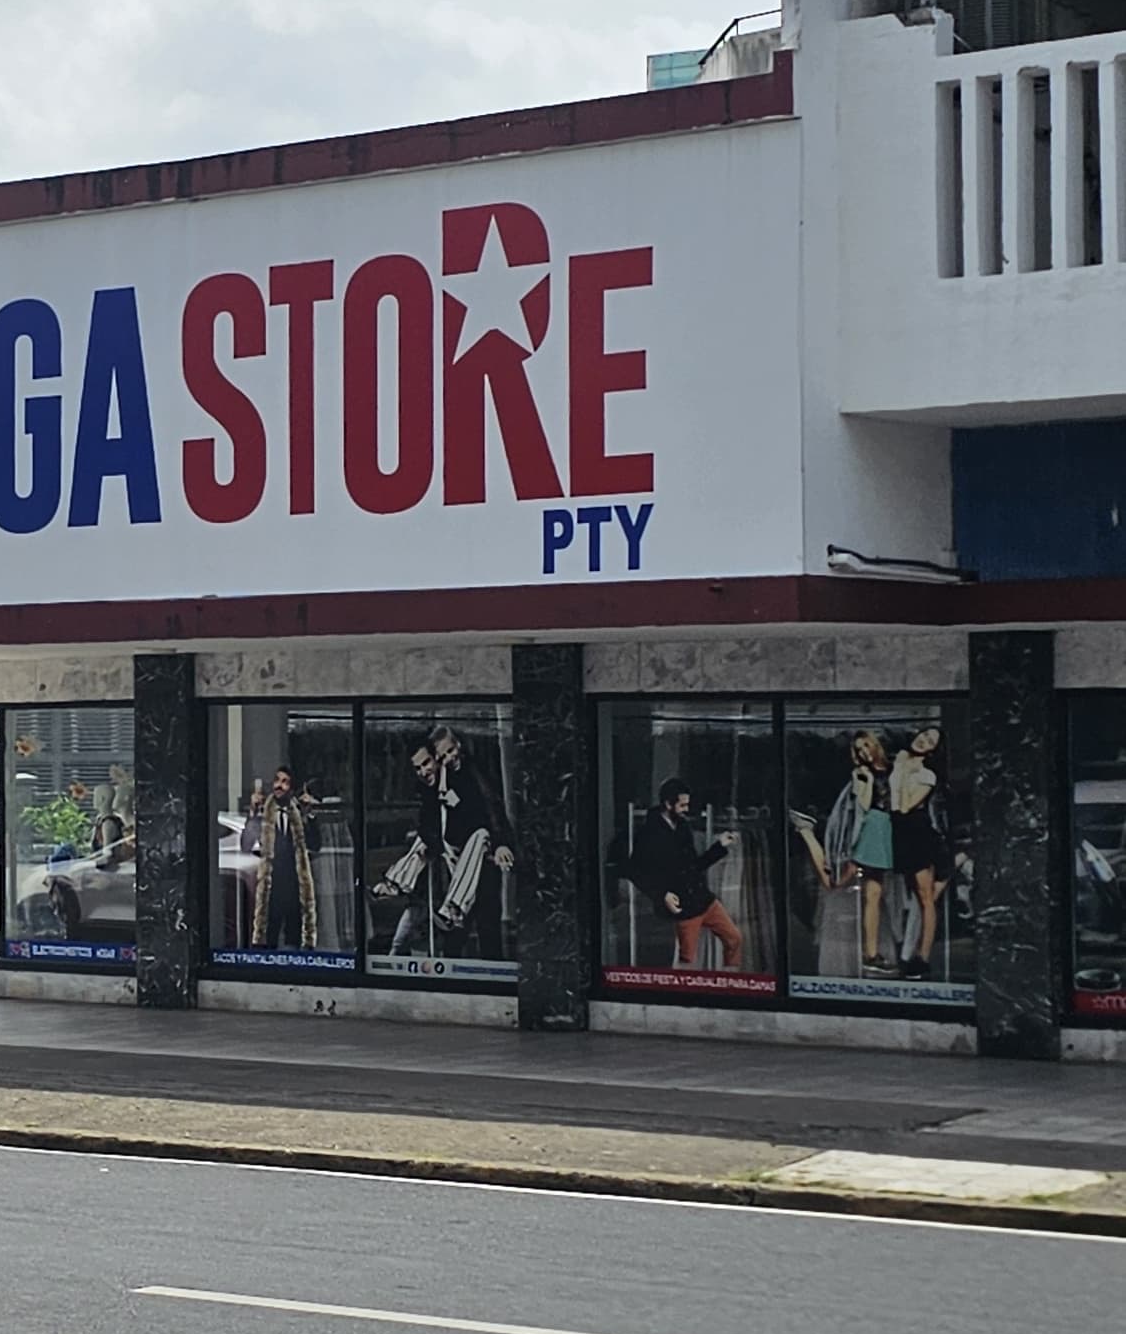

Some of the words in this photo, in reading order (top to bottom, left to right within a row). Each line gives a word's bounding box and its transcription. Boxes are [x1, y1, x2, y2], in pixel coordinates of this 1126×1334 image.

[544, 503, 653, 572] PTY
[289, 956, 307, 966] PARA
[308, 956, 355, 969] CABALLEROS
[729, 979, 749, 989] PARA
[792, 981, 838, 995] CALZADO
[839, 984, 865, 995] PARA
